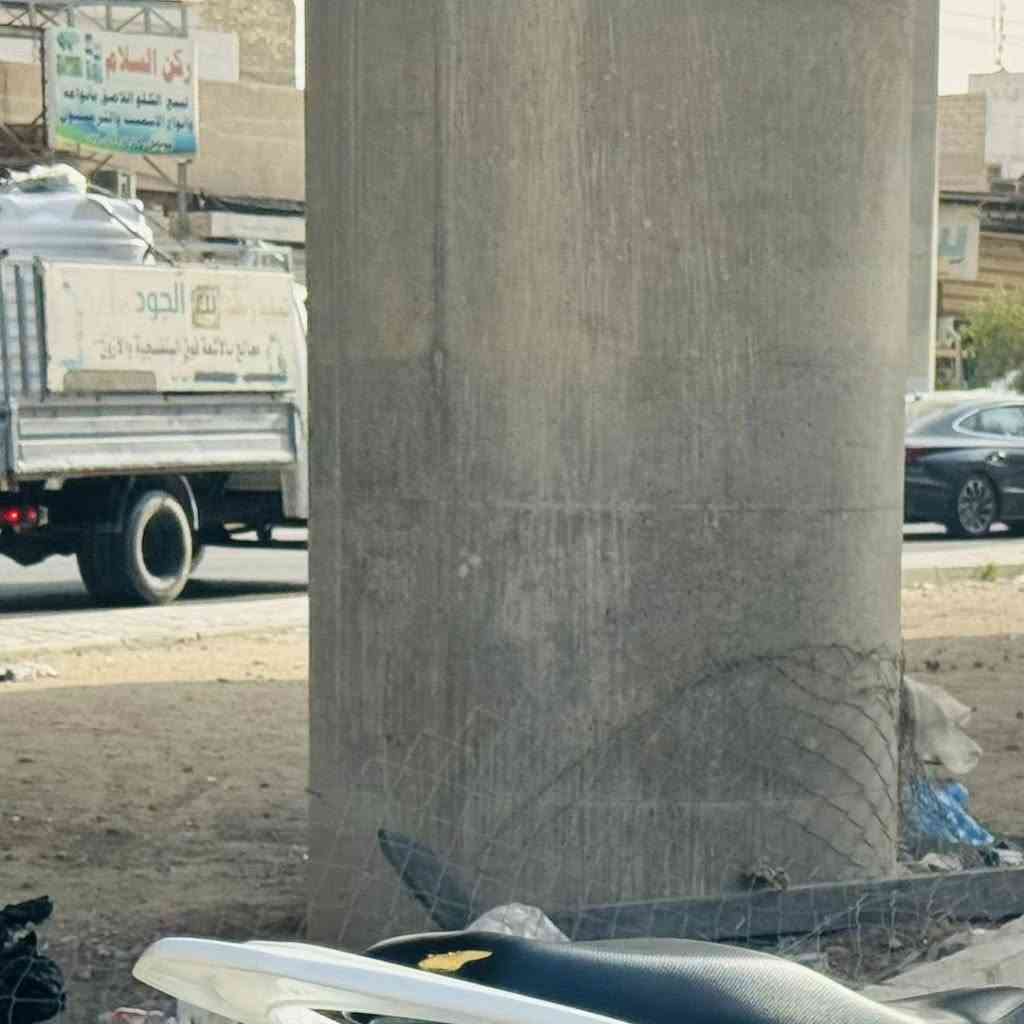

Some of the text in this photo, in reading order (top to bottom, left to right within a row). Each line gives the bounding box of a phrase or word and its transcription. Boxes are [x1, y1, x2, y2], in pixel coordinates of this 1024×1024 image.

[106, 46, 157, 80] السلام
[163, 49, 191, 84] ركن
[136, 281, 185, 320] الجود
